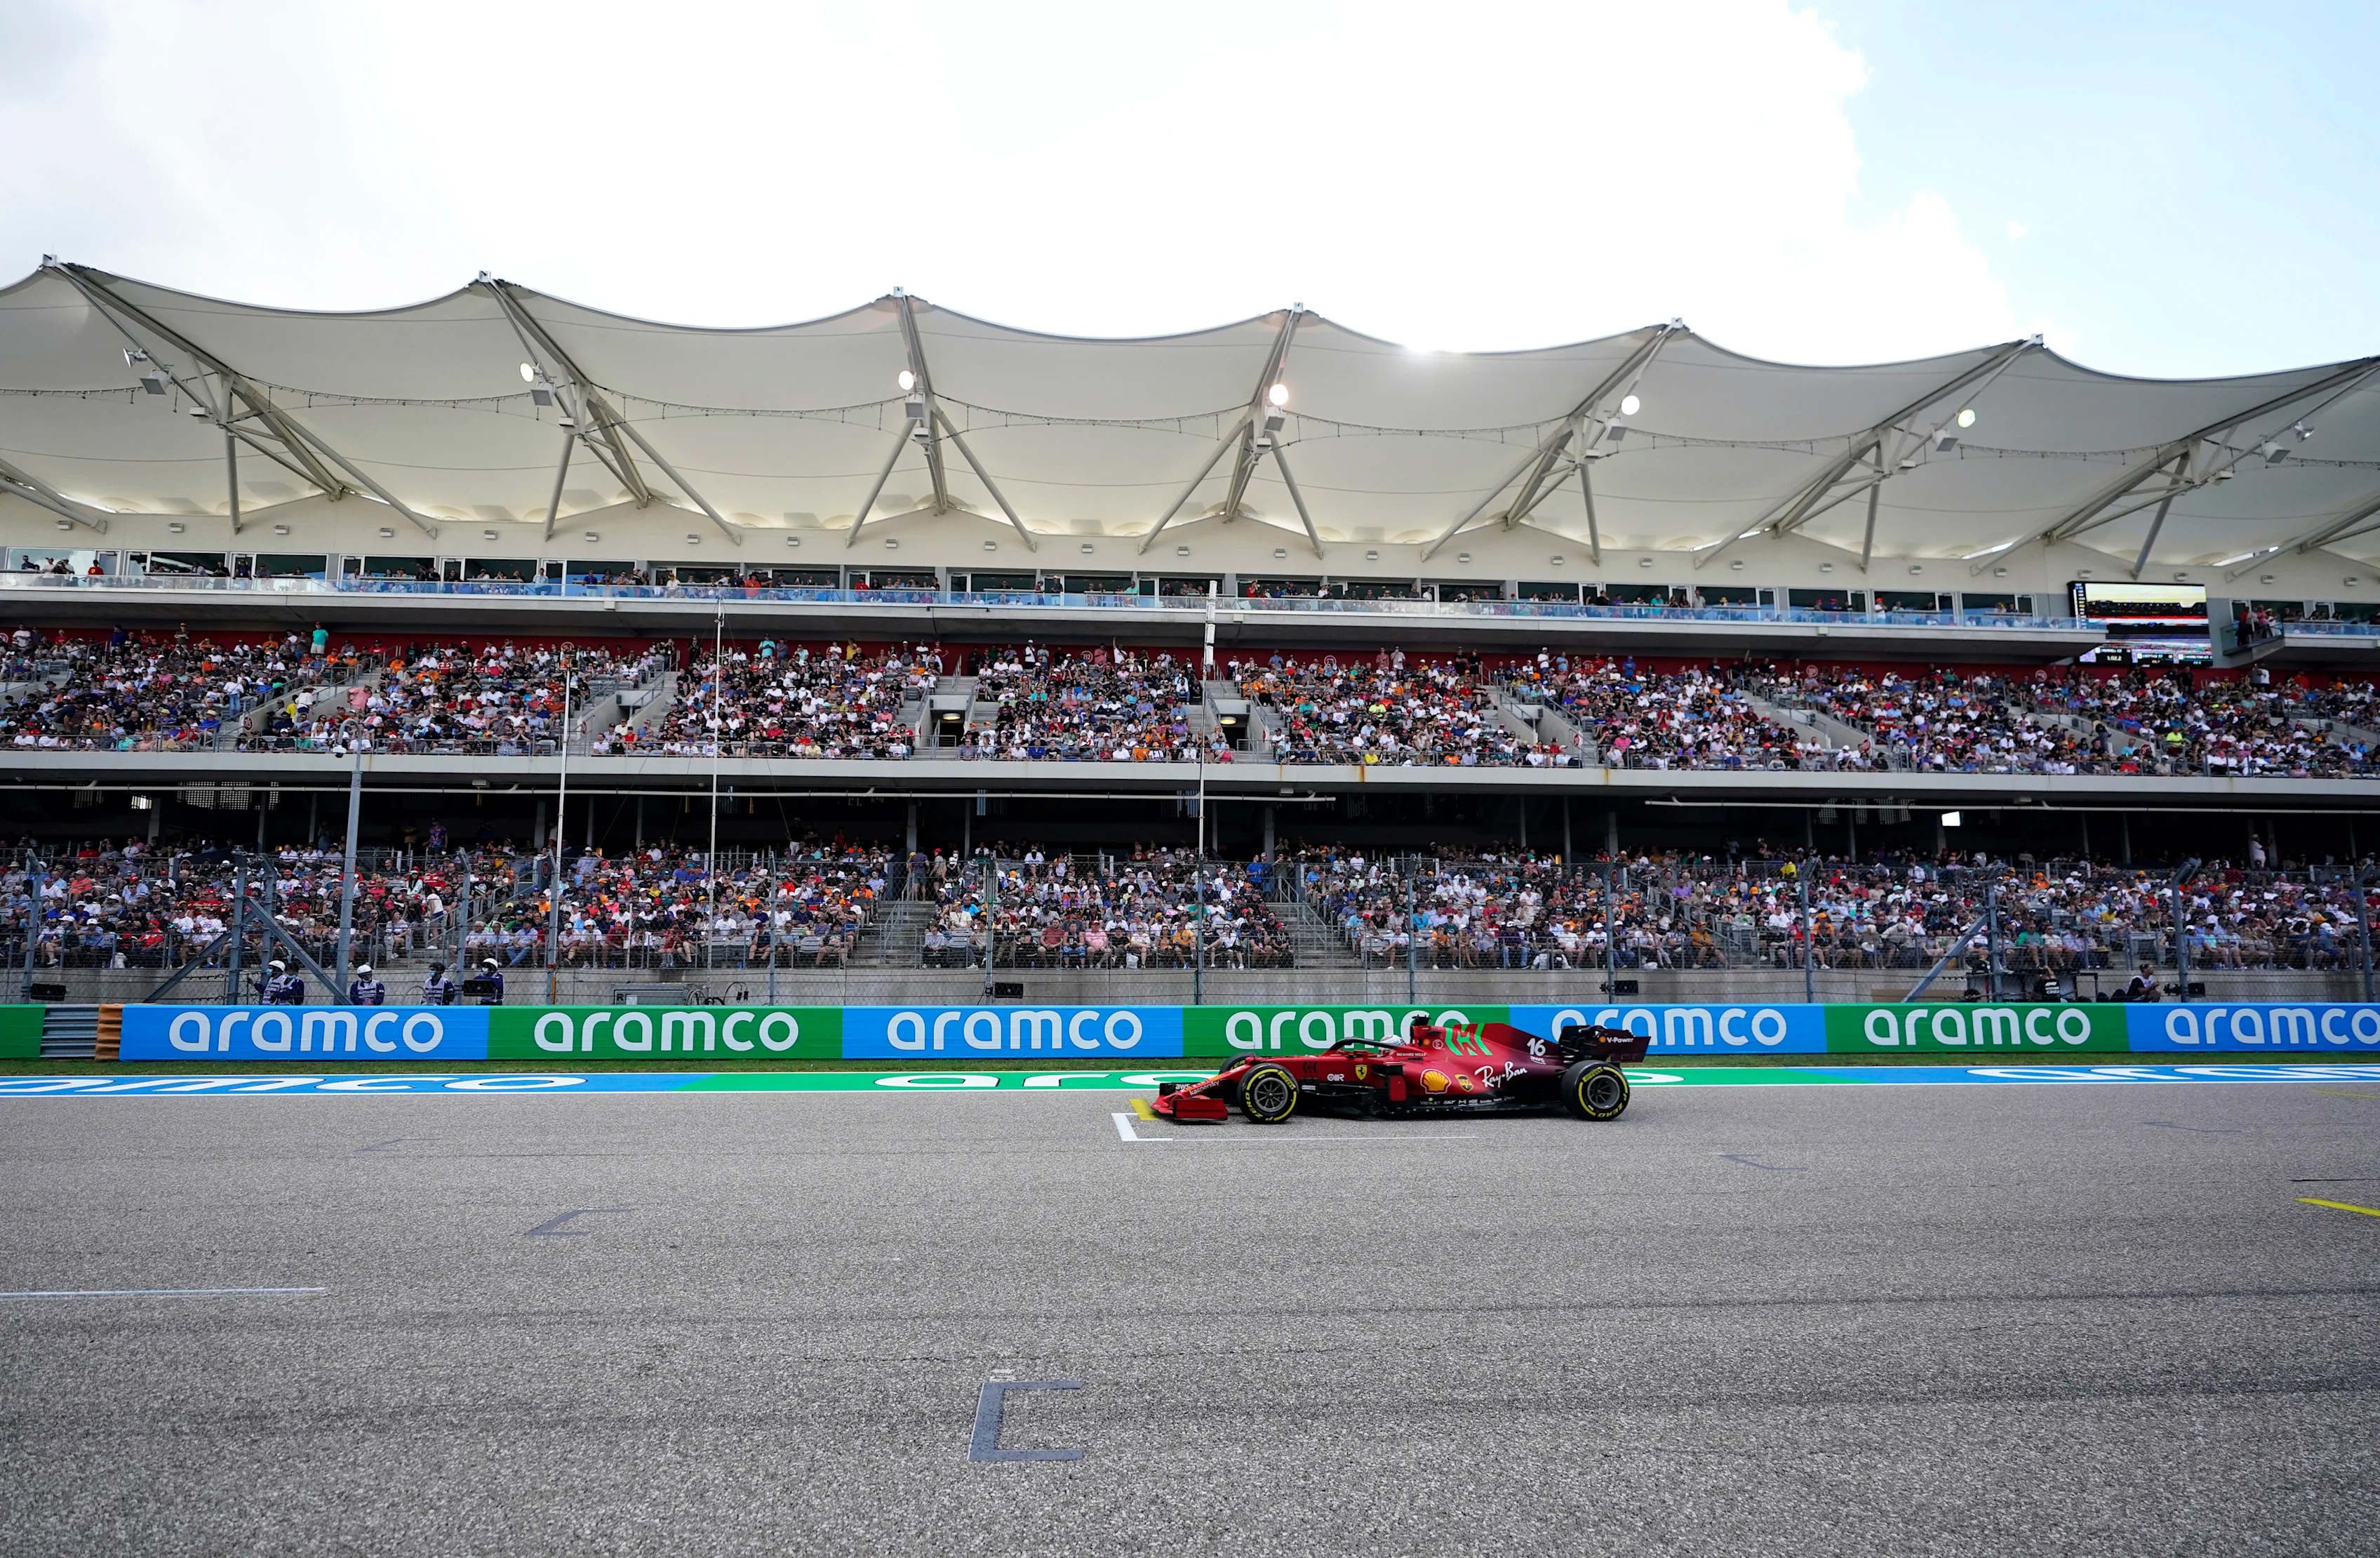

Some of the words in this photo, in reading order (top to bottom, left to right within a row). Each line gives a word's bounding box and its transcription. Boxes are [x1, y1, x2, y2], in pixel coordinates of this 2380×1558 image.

[169, 1012, 443, 1052] aramco
[535, 1012, 798, 1051] aramco
[887, 1011, 1142, 1050] aramco
[1864, 1008, 2091, 1046] aramco
[2165, 1008, 2380, 1044] aramco
[1527, 1038, 1546, 1056] 16
[1189, 1081, 1219, 1096] kaspersky
[1245, 1092, 1264, 1118] ZERO
[1598, 1103, 1624, 1117] ZERO
